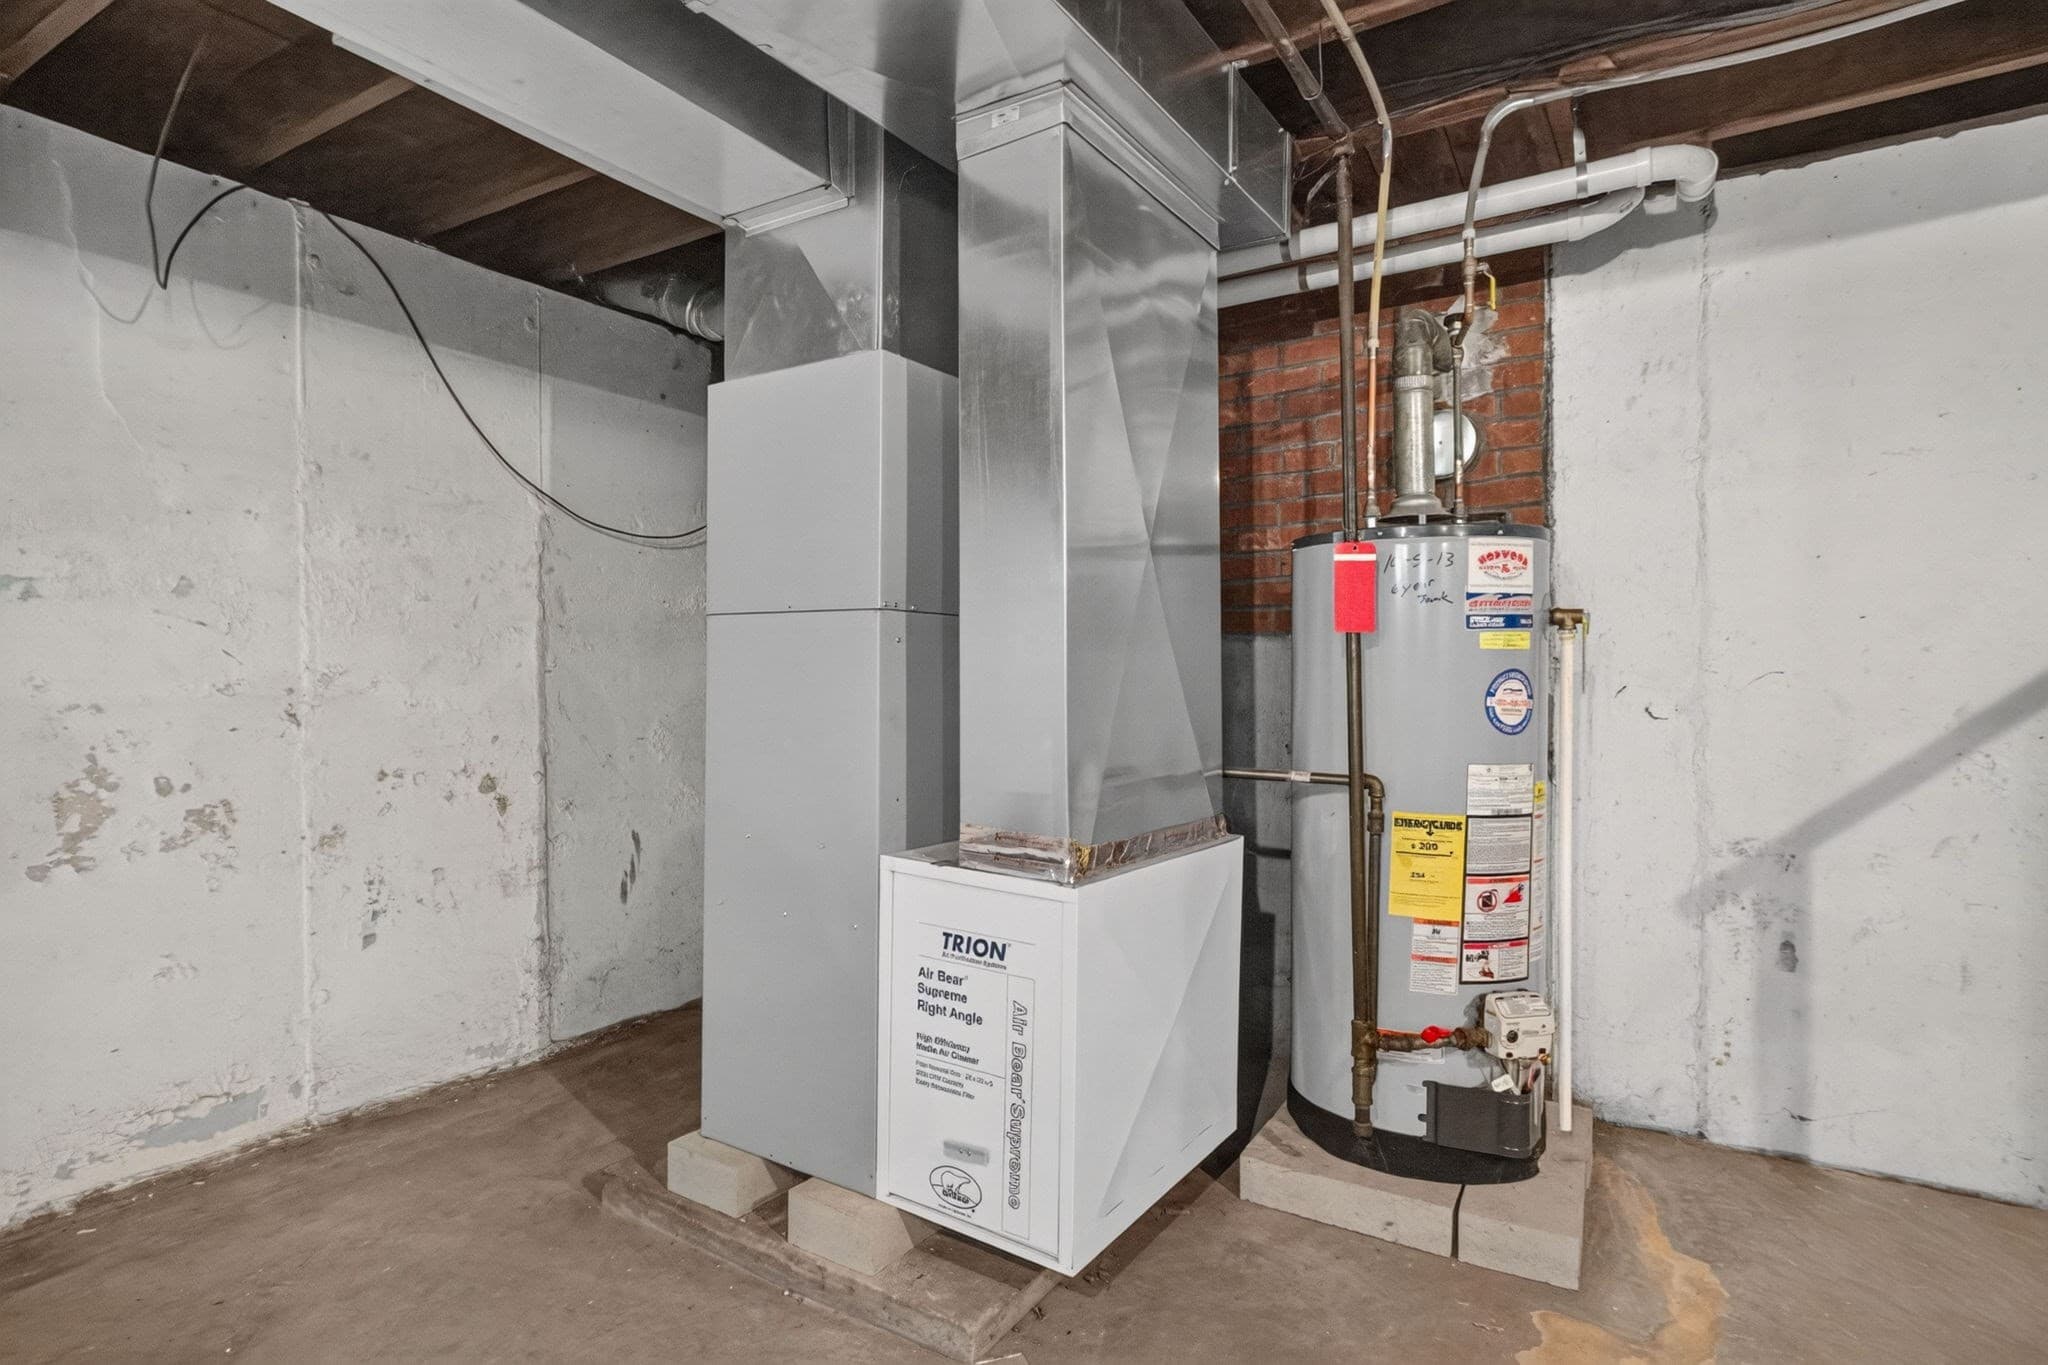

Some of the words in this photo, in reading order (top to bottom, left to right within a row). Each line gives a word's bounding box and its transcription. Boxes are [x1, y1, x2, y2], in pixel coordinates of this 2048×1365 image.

[942, 931, 1007, 961] TRION
[918, 966, 934, 980] Air
[937, 970, 963, 986] Bear
[917, 982, 968, 1004] Supreme
[917, 999, 947, 1017] Right
[949, 1007, 983, 1026] Angle
[1011, 1000, 1028, 1036] Air
[1010, 1041, 1027, 1100] Bear
[1006, 1102, 1026, 1210] Supreme
